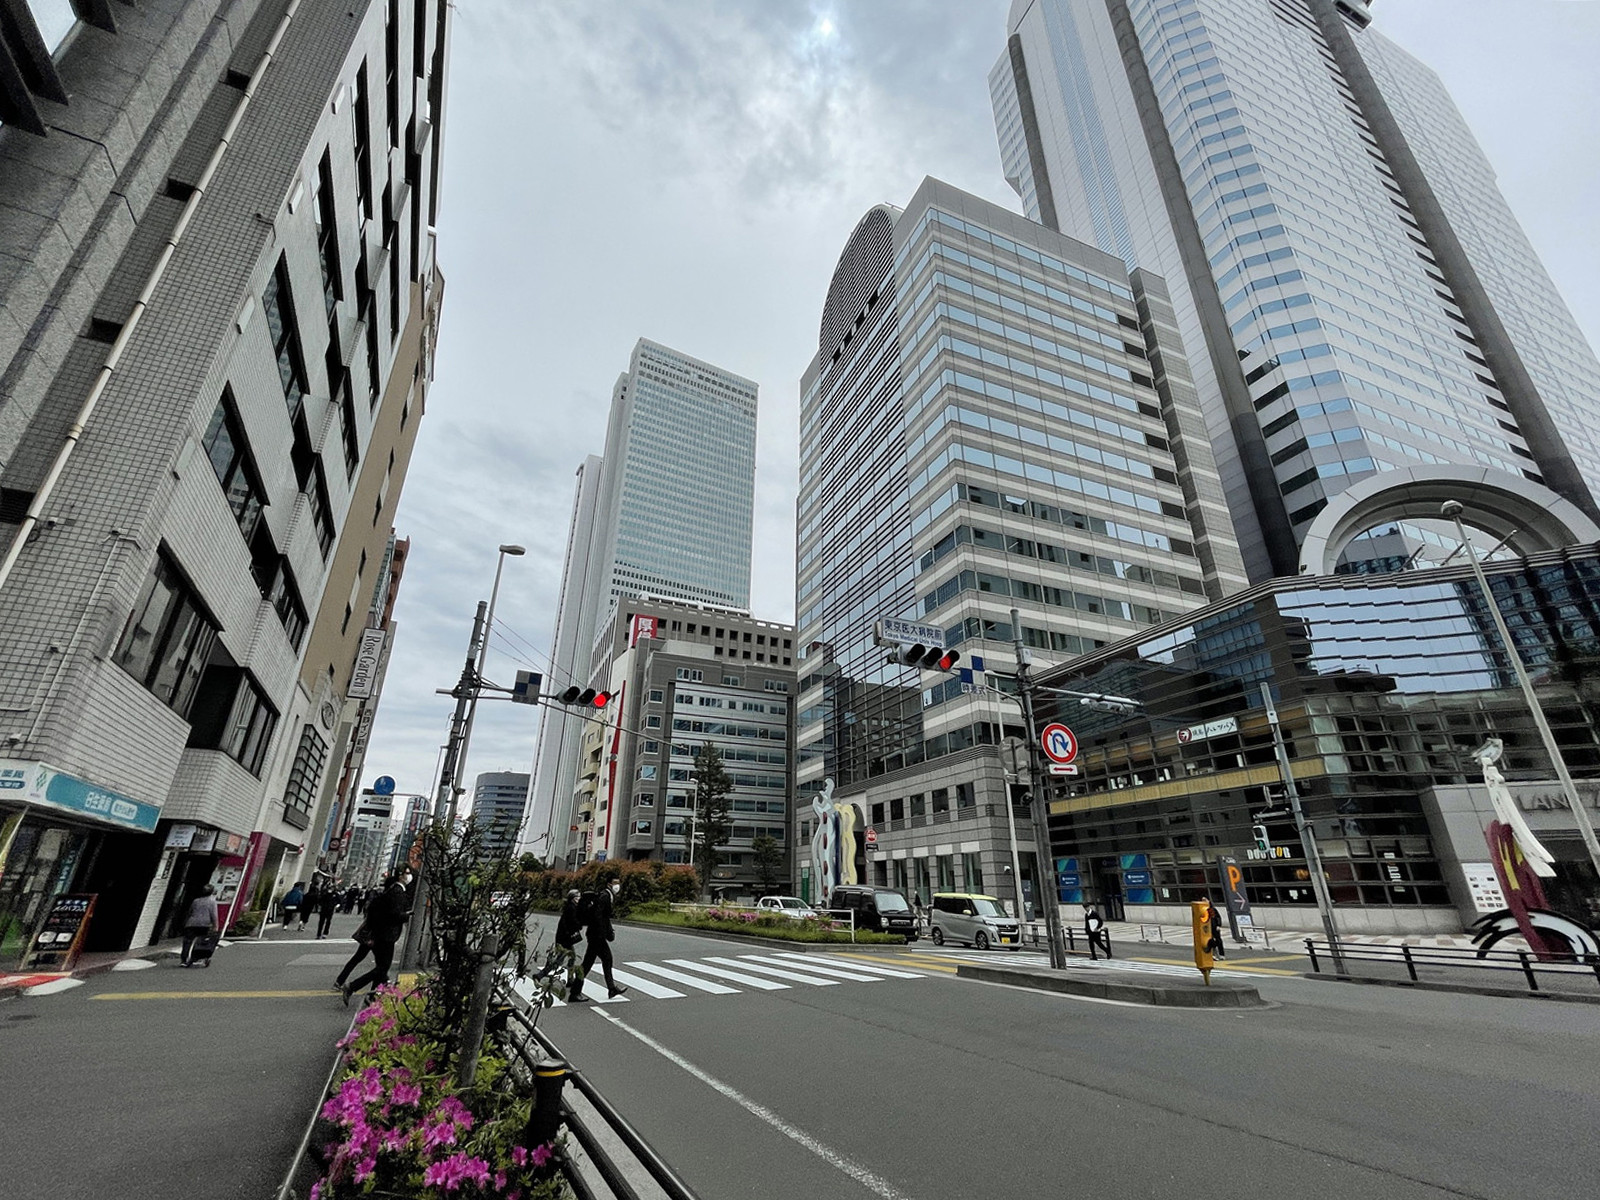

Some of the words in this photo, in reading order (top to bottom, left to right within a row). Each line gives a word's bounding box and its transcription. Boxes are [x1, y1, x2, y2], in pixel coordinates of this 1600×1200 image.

[885, 619, 942, 641] 東京医大病院前
[362, 634, 382, 656] Rose
[352, 654, 377, 689] Garden
[1227, 865, 1241, 893] P
